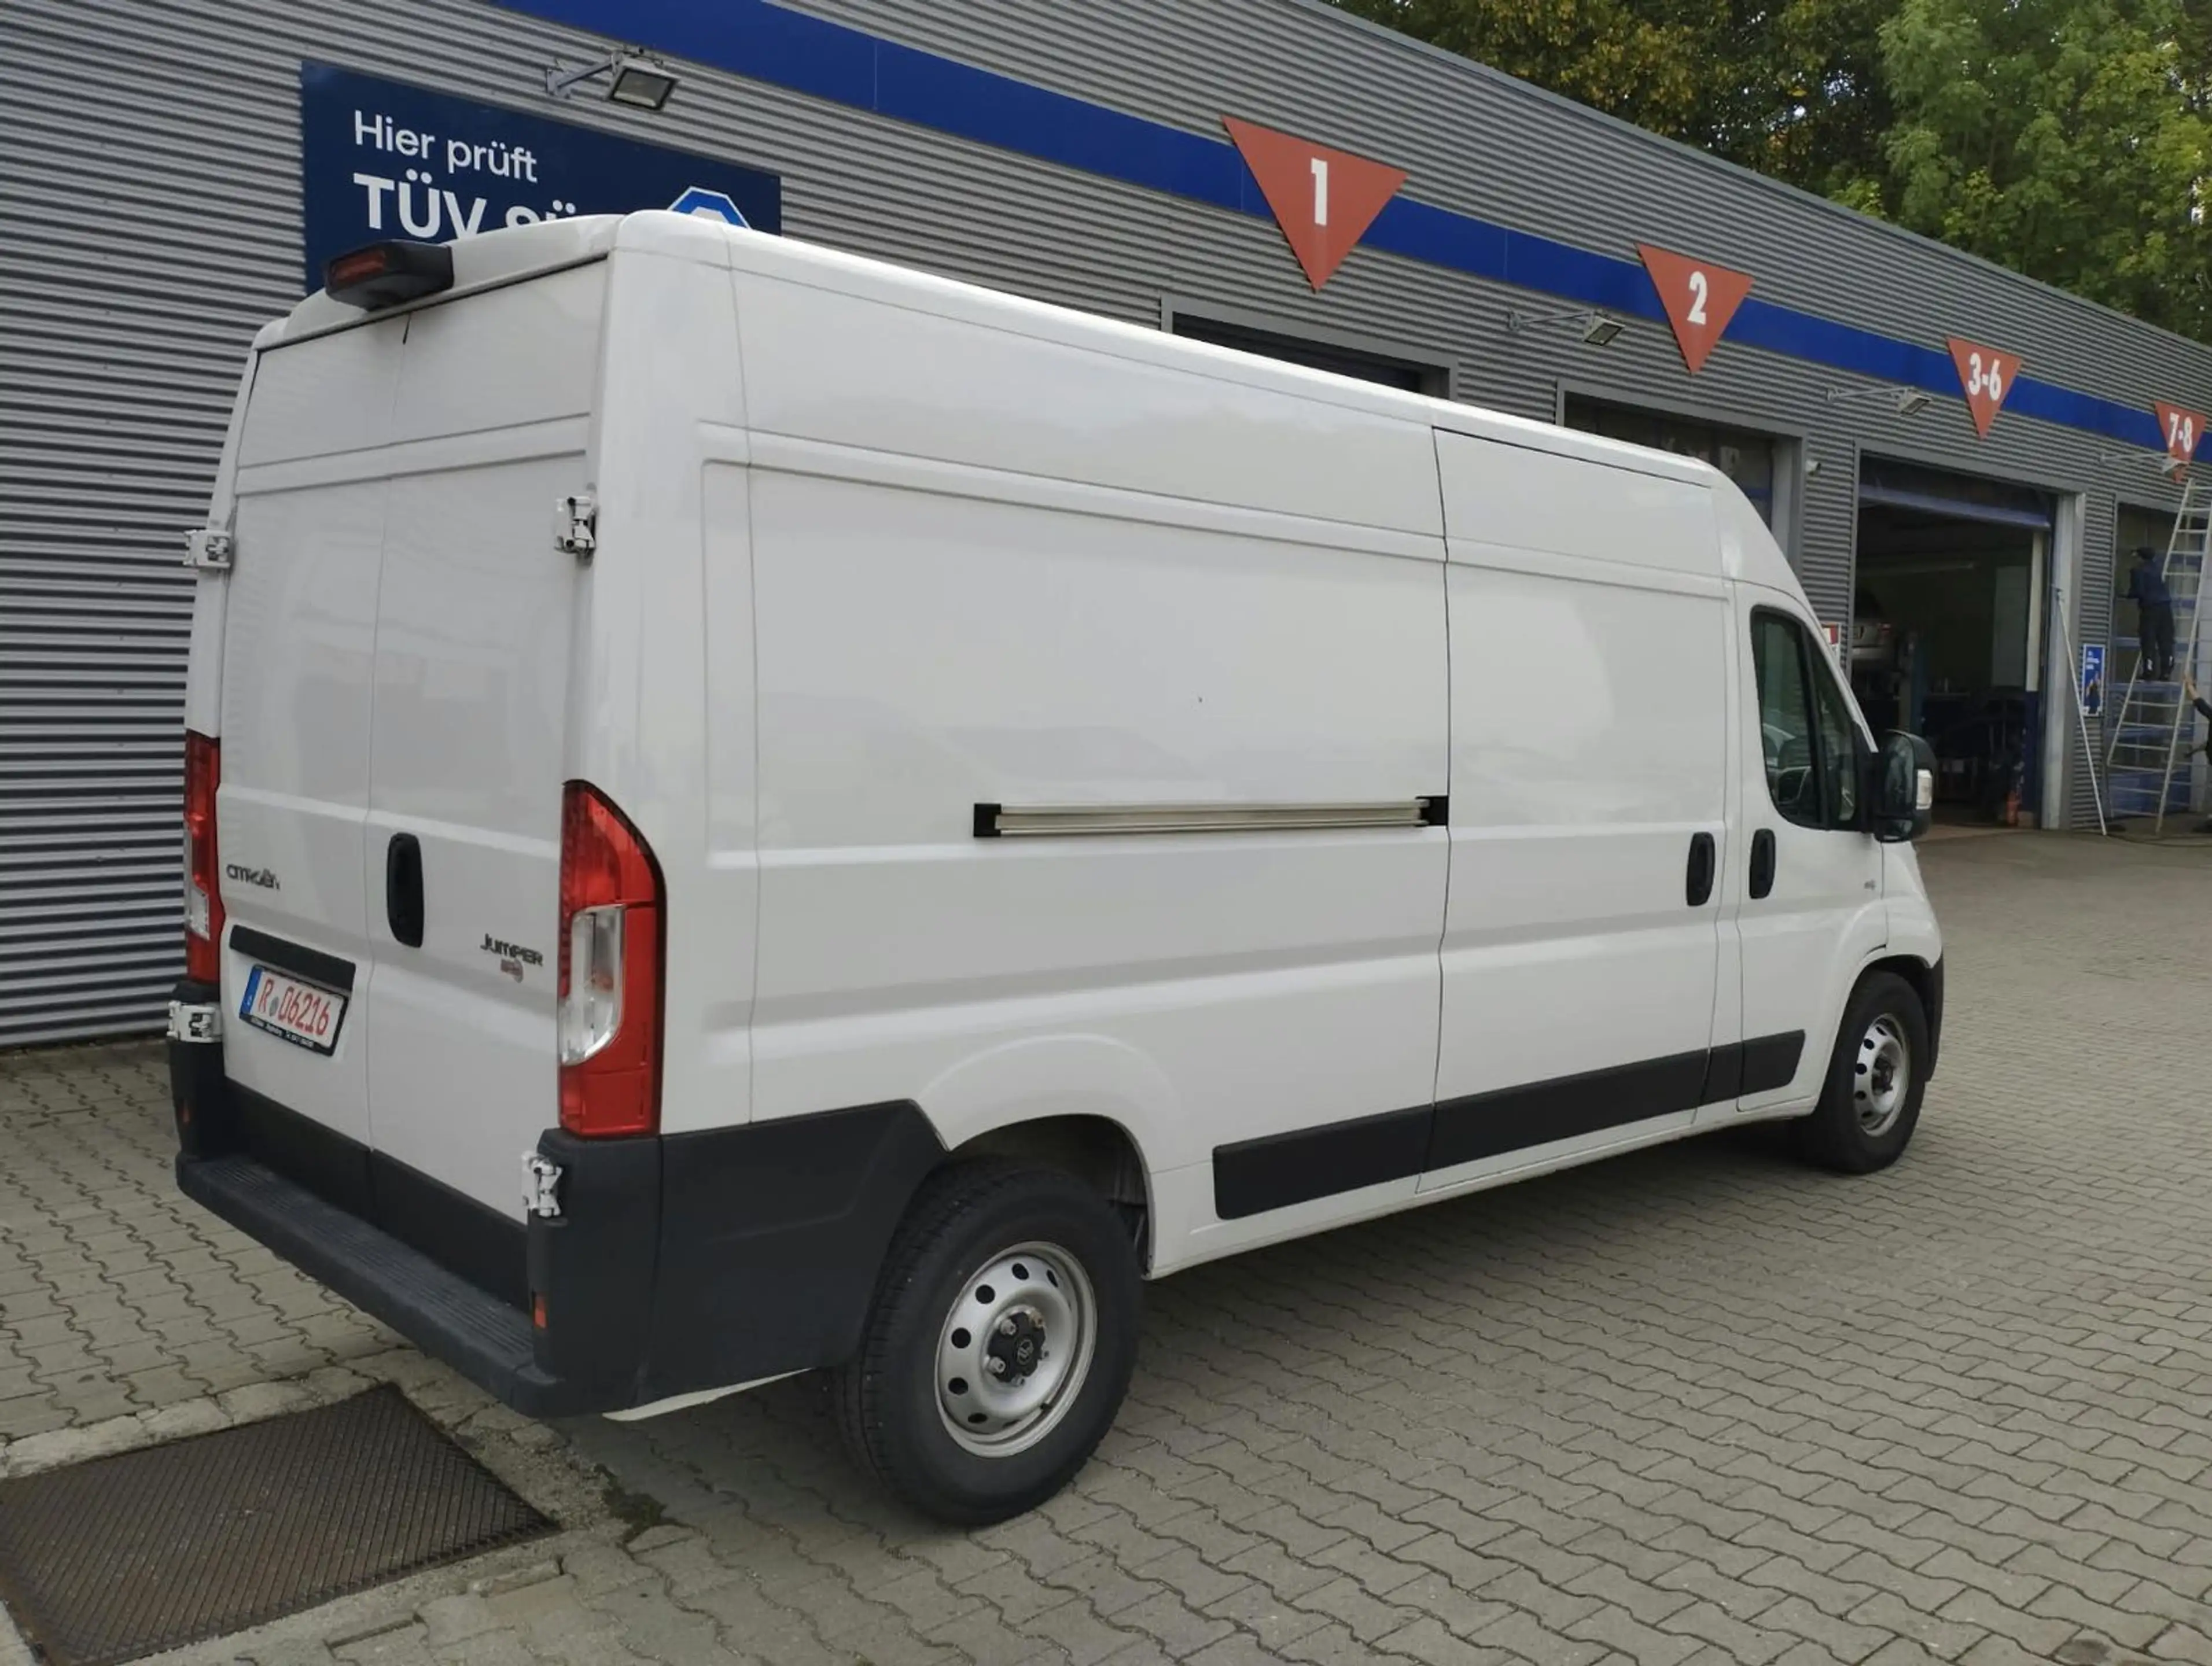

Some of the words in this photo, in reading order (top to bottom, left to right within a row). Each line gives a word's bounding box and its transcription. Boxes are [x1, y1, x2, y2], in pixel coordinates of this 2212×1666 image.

[355, 109, 435, 160] Hier
[447, 139, 538, 183] prüft
[353, 168, 487, 239] TÜV
[1311, 157, 1328, 226] 1
[1687, 271, 1707, 325] 2
[1968, 352, 2002, 401] 3-6
[2169, 412, 2192, 452] 7-8
[258, 978, 275, 1013] R
[278, 986, 332, 1036] 06216
